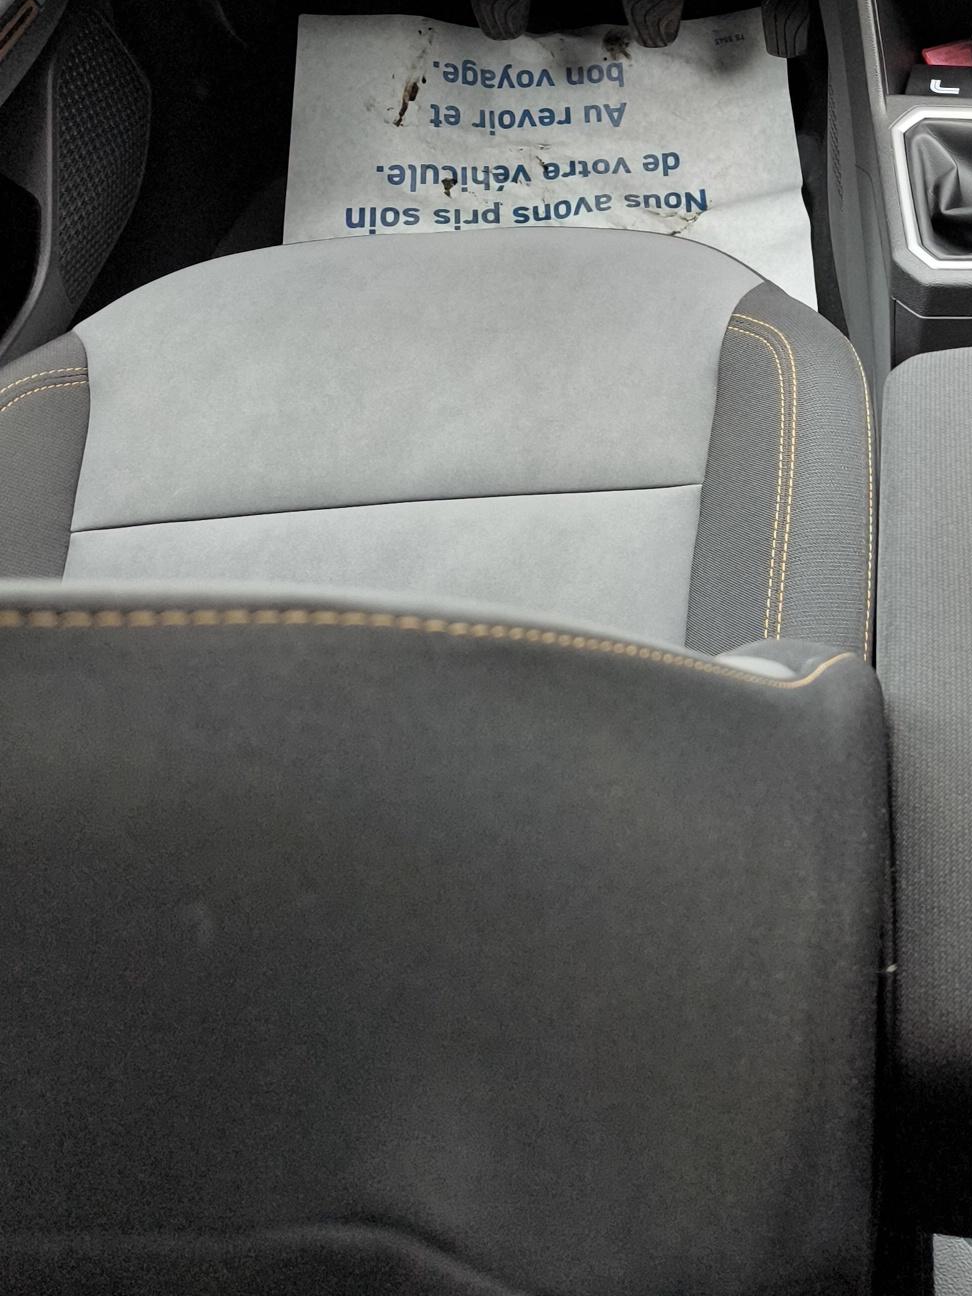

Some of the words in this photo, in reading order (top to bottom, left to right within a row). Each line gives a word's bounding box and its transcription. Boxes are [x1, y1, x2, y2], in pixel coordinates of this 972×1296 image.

[433, 59, 556, 89] voyage.
[566, 61, 625, 88] bon
[430, 104, 461, 128] et
[471, 106, 572, 136] revoir
[584, 102, 627, 128] Au
[542, 157, 632, 180] votre
[643, 151, 680, 176] de
[376, 163, 533, 193] véhicule.
[513, 194, 613, 224] avons
[624, 189, 708, 213] Nous
[345, 206, 420, 235] soin
[433, 202, 501, 231] pris
